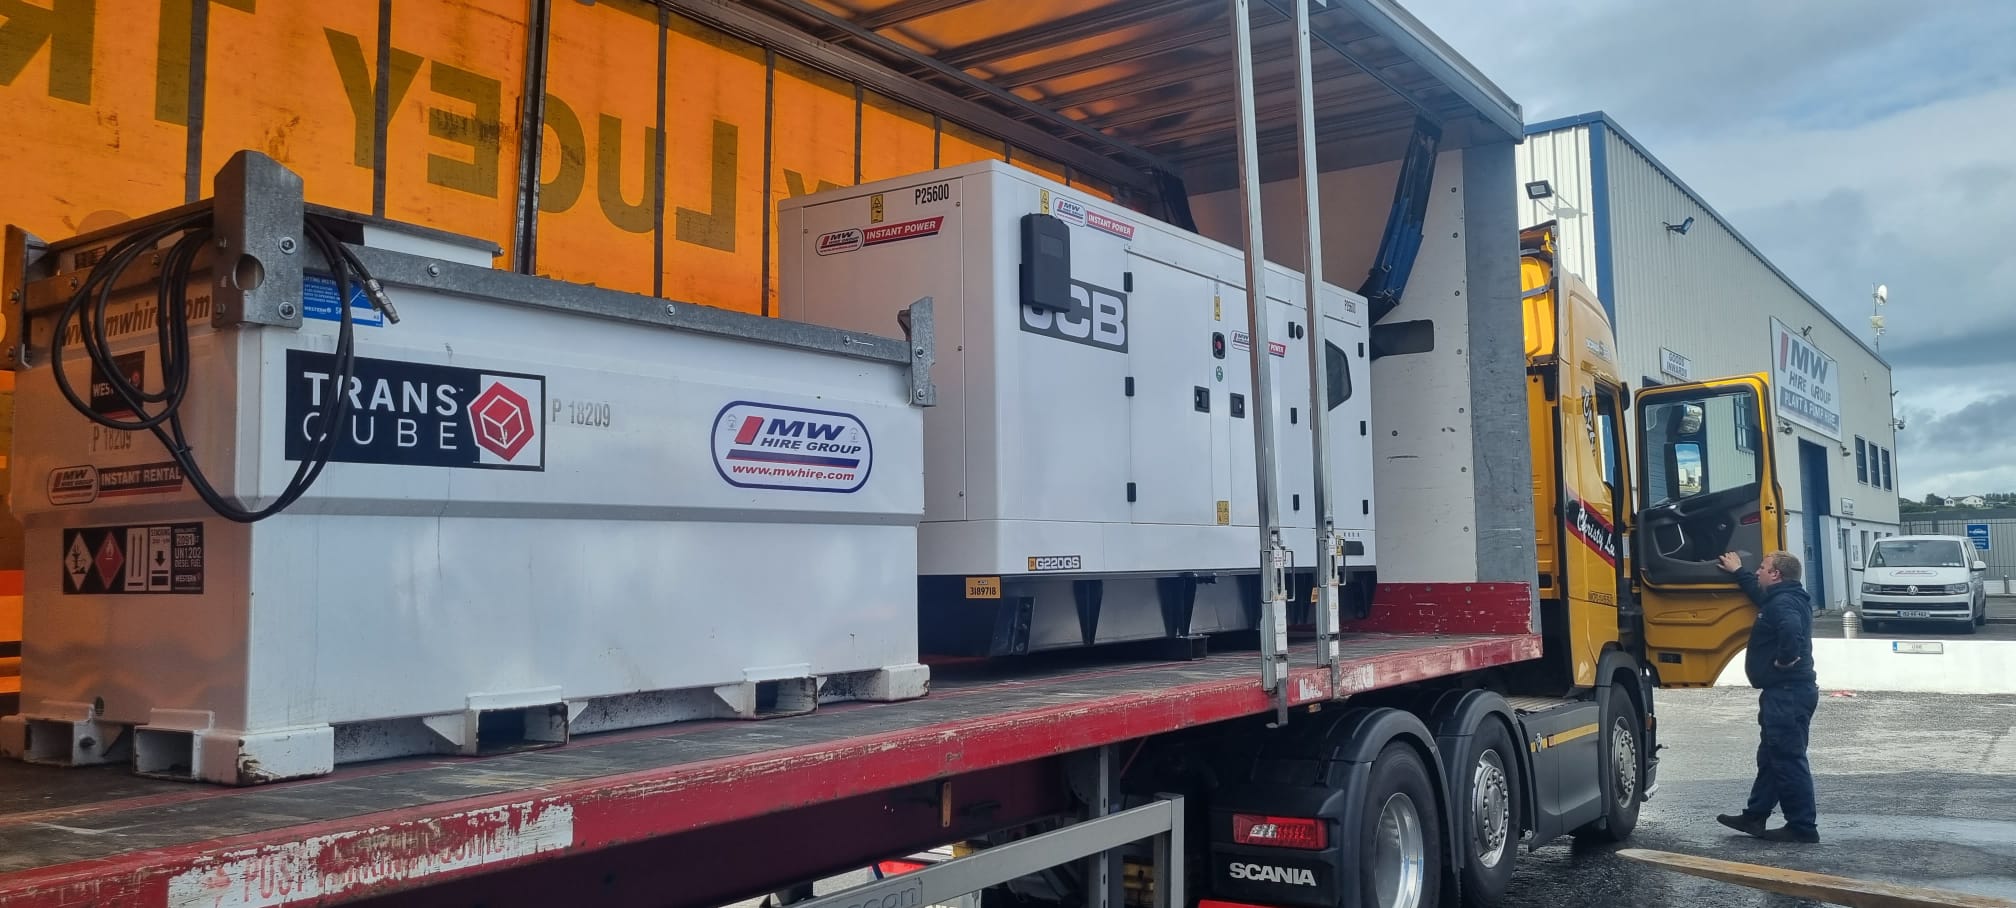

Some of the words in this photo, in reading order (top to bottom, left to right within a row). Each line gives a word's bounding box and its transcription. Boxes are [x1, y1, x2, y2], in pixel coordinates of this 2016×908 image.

[915, 183, 950, 206] P25600
[866, 226, 902, 240] INSTANT
[905, 220, 936, 234] POWER
[1088, 213, 1111, 229] INSTANT
[1111, 221, 1131, 235] POWER
[1668, 352, 1685, 367] GOODS
[1790, 338, 1828, 384] MW
[303, 371, 458, 416] TRANS
[1789, 370, 1807, 393] HIRE
[1811, 383, 1832, 405] GROUP
[1784, 391, 1802, 411] PLANT
[552, 398, 562, 422] P
[568, 402, 611, 428] 18209
[93, 426, 100, 451] P
[103, 427, 132, 451] 18209
[302, 412, 457, 450] CUBE
[766, 418, 845, 441] MW
[760, 437, 803, 450] HIRE
[806, 442, 861, 455] GROUP
[101, 470, 141, 486] INSTANT
[143, 466, 182, 482] RENTAL
[732, 464, 855, 481] www.mwhire.com
[175, 546, 202, 559] UN1202
[1229, 862, 1317, 887] SCANIA
